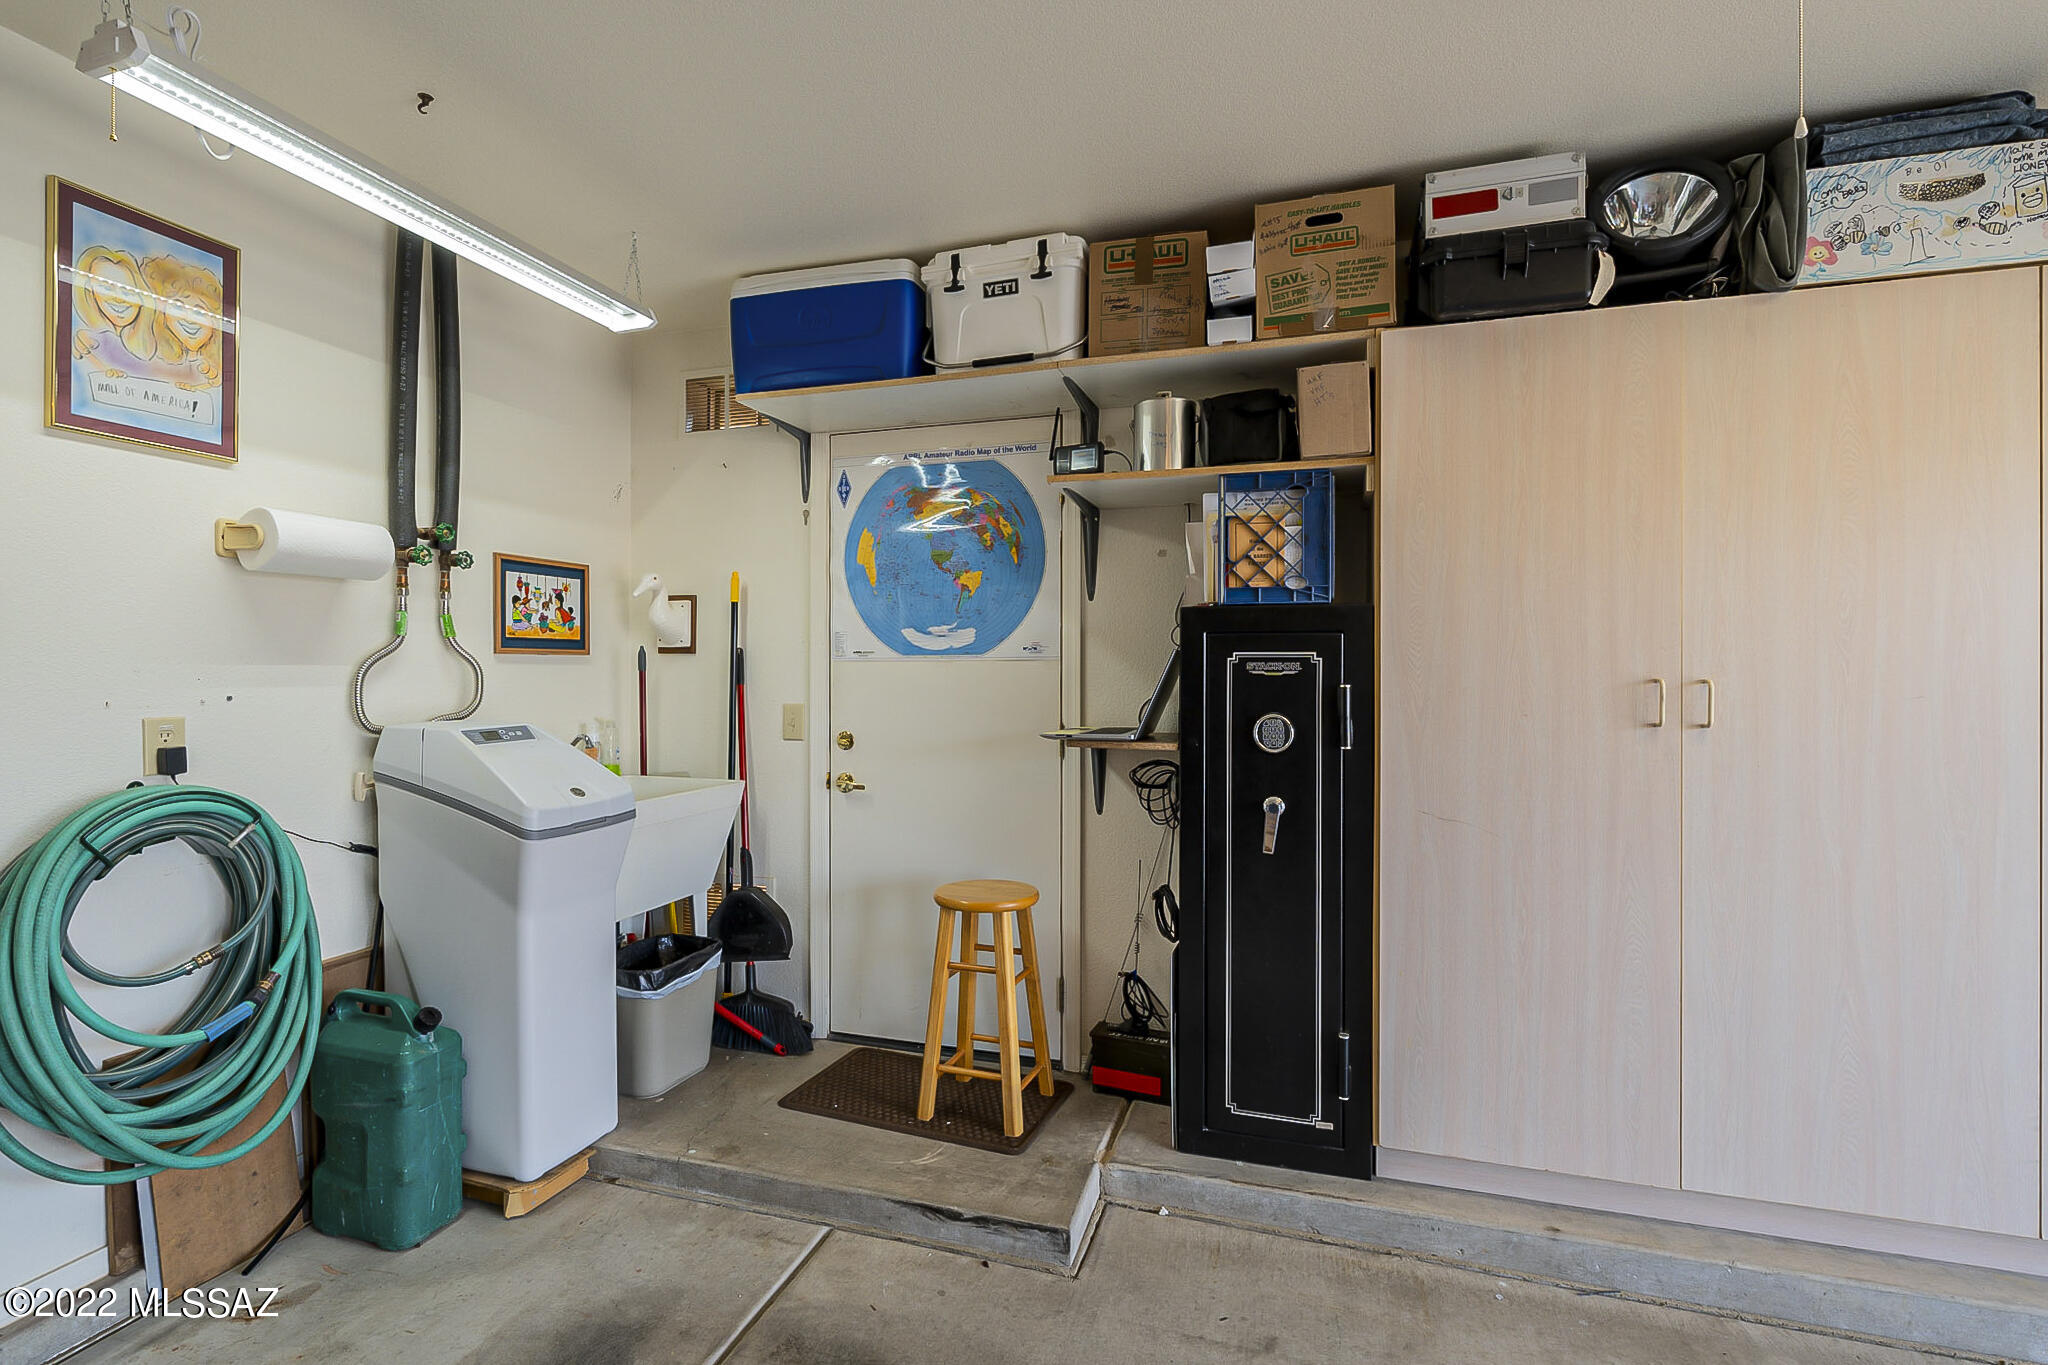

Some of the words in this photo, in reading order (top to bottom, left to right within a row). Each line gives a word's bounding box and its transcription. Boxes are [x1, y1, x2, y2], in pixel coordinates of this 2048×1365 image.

[1295, 230, 1355, 247] U-HAUL
[985, 281, 1016, 296] YETI
[97, 383, 119, 395] MALL
[924, 451, 953, 459] Amateur
[955, 449, 975, 457] Radio
[976, 448, 991, 456] Map
[1002, 445, 1013, 453] the
[1015, 444, 1037, 452] World
